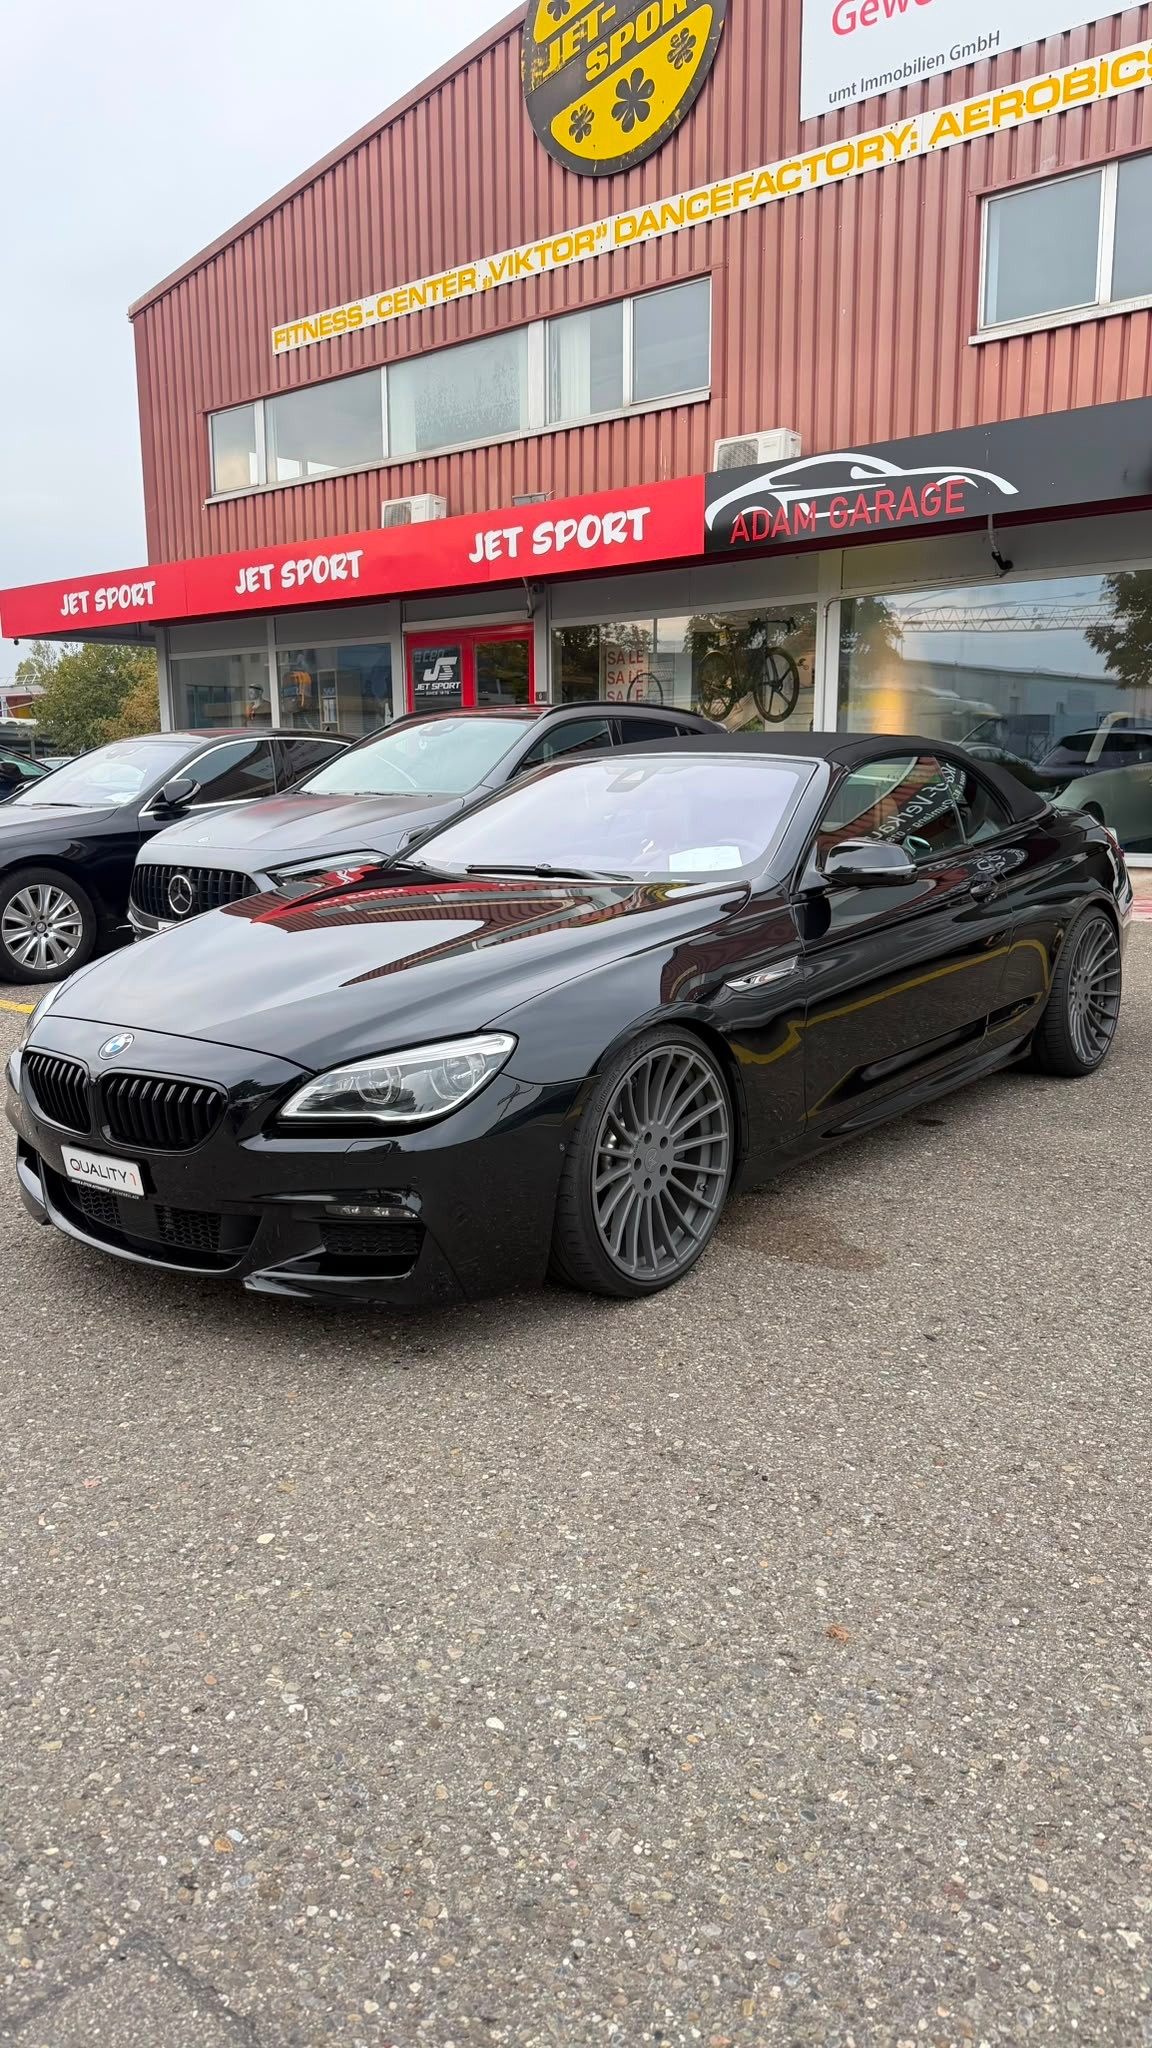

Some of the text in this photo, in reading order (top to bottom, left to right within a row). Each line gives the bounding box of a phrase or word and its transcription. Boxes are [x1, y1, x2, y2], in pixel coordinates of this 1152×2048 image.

[828, 30, 1000, 104] umt Immobilien GmbH
[614, 124, 918, 245] DANCEFACTORY:
[928, 47, 1152, 146] AEROBIC
[469, 506, 651, 563] JET SPORT
[730, 479, 966, 545] ADAM GARAGE
[235, 550, 363, 594] JET SPORT
[60, 580, 156, 616] JET SPORT
[415, 682, 461, 691] JET SPORT
[69, 1158, 127, 1184] QUALITY
